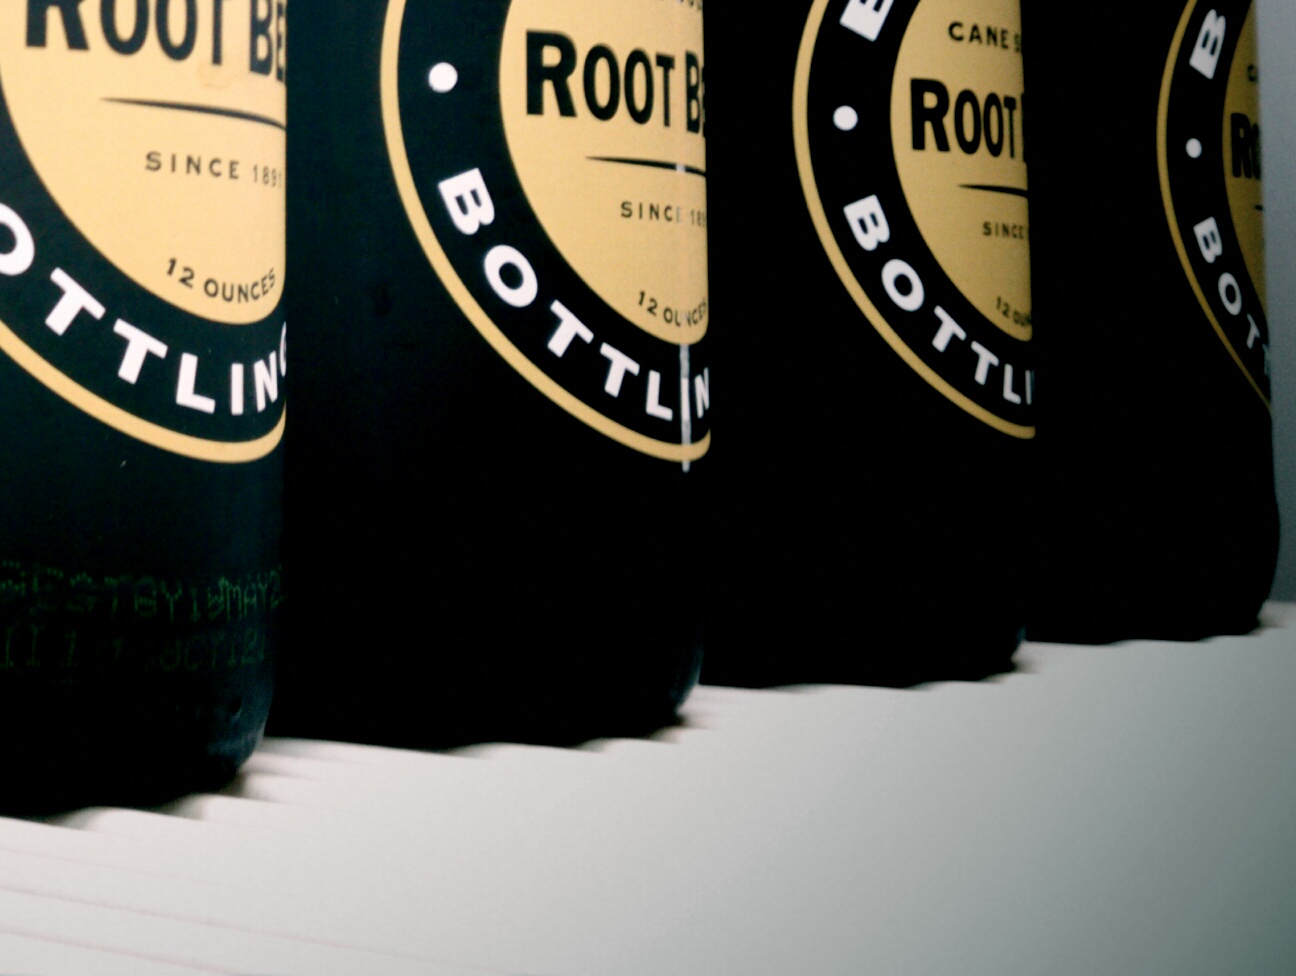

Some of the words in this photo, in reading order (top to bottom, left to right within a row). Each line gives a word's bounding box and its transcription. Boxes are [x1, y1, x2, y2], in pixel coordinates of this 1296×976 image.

[948, 21, 1009, 50] CANE
[525, 28, 676, 127] ROOT
[910, 78, 1016, 159] ROOT
[144, 151, 240, 181] SINCE
[165, 257, 195, 287] 12
[203, 268, 278, 304] OUNCES
[638, 289, 658, 317] 12
